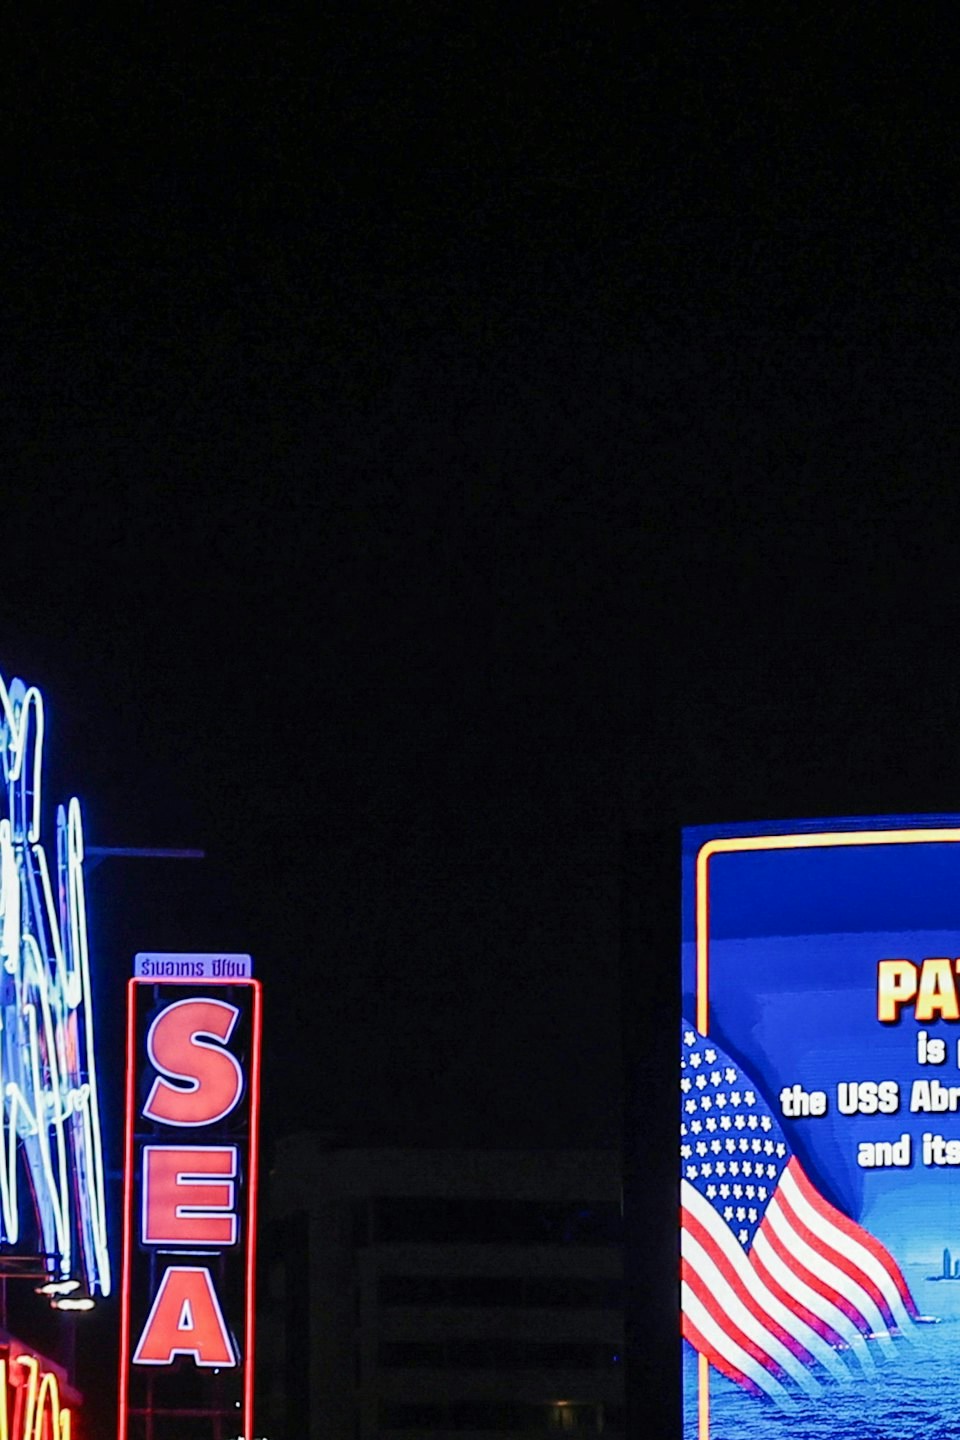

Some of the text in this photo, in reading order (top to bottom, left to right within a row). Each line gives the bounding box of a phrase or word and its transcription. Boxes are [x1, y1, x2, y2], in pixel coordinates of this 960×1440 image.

[917, 1030, 946, 1065] is
[780, 1084, 828, 1117] the
[837, 1080, 899, 1115] USS
[857, 1132, 911, 1168] and
[132, 997, 244, 1368] SEA
